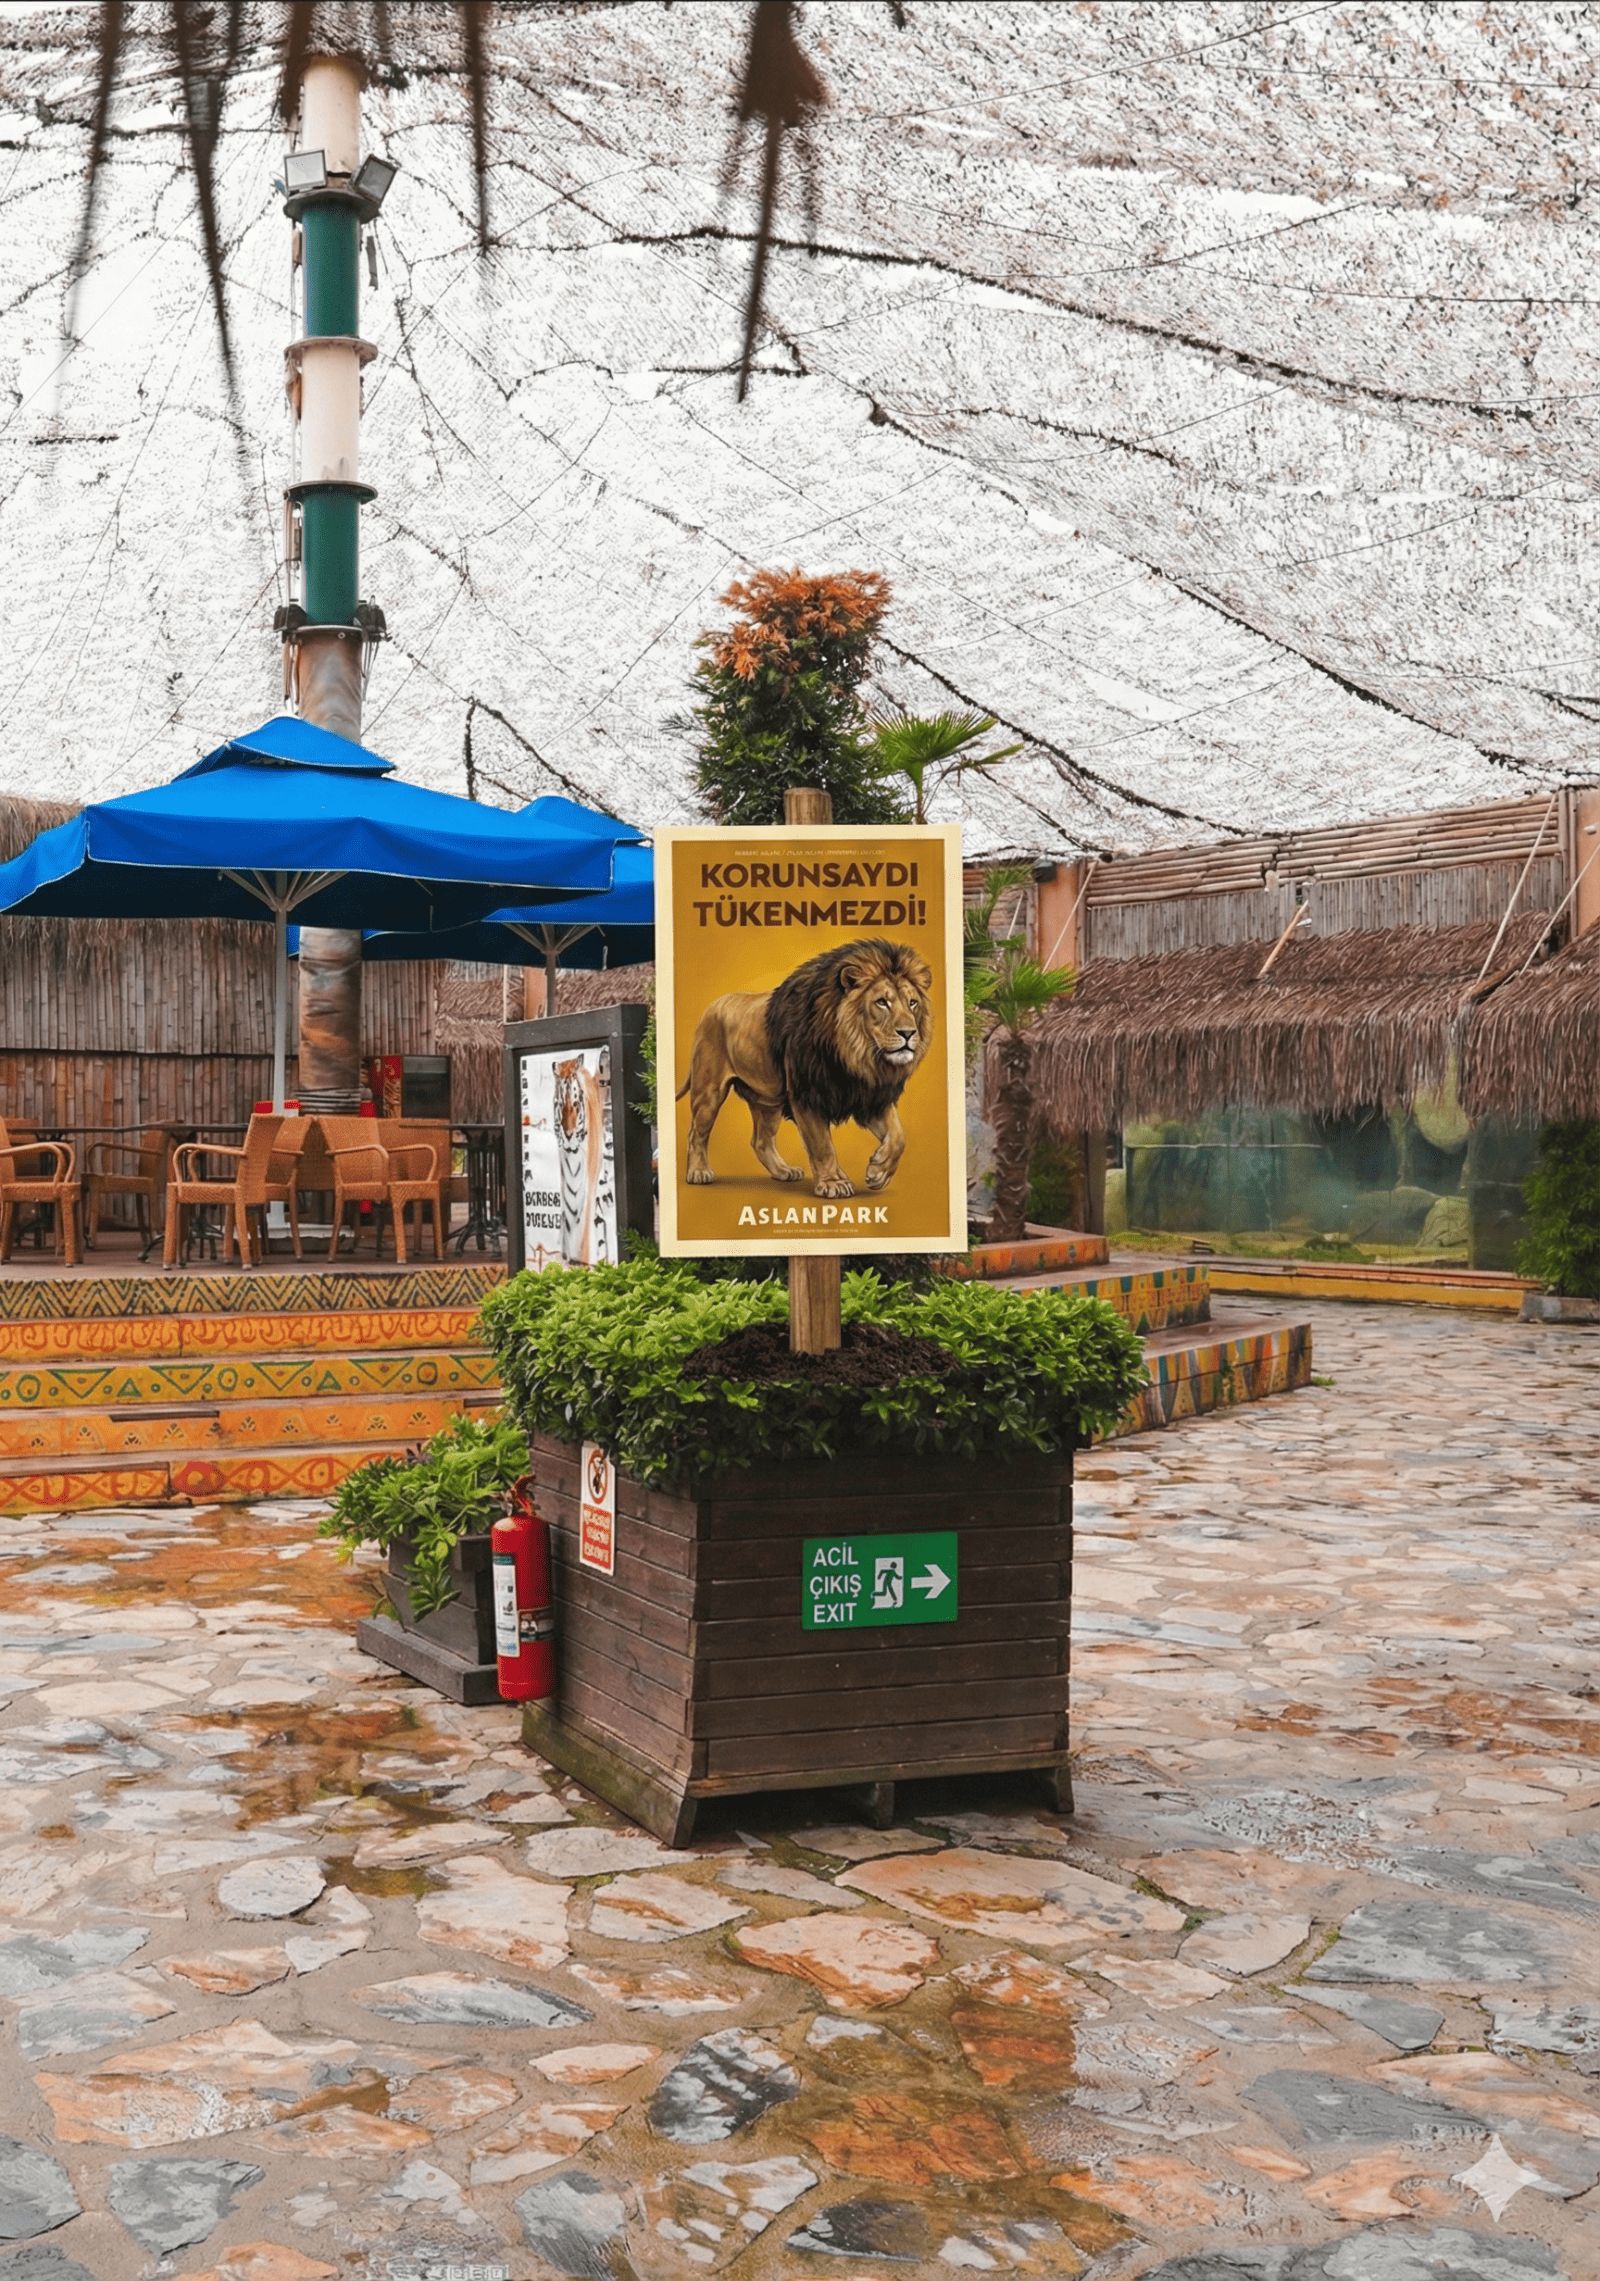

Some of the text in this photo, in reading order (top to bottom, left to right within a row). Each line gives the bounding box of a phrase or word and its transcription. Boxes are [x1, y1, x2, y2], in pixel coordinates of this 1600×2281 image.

[701, 862, 918, 888] KORUNSAYDI
[693, 893, 926, 926] TÜKENMEZDİ!
[813, 1542, 858, 1567] ACİL
[809, 1574, 862, 1600] ÇIKIŞ
[814, 1602, 857, 1623] EXIT
